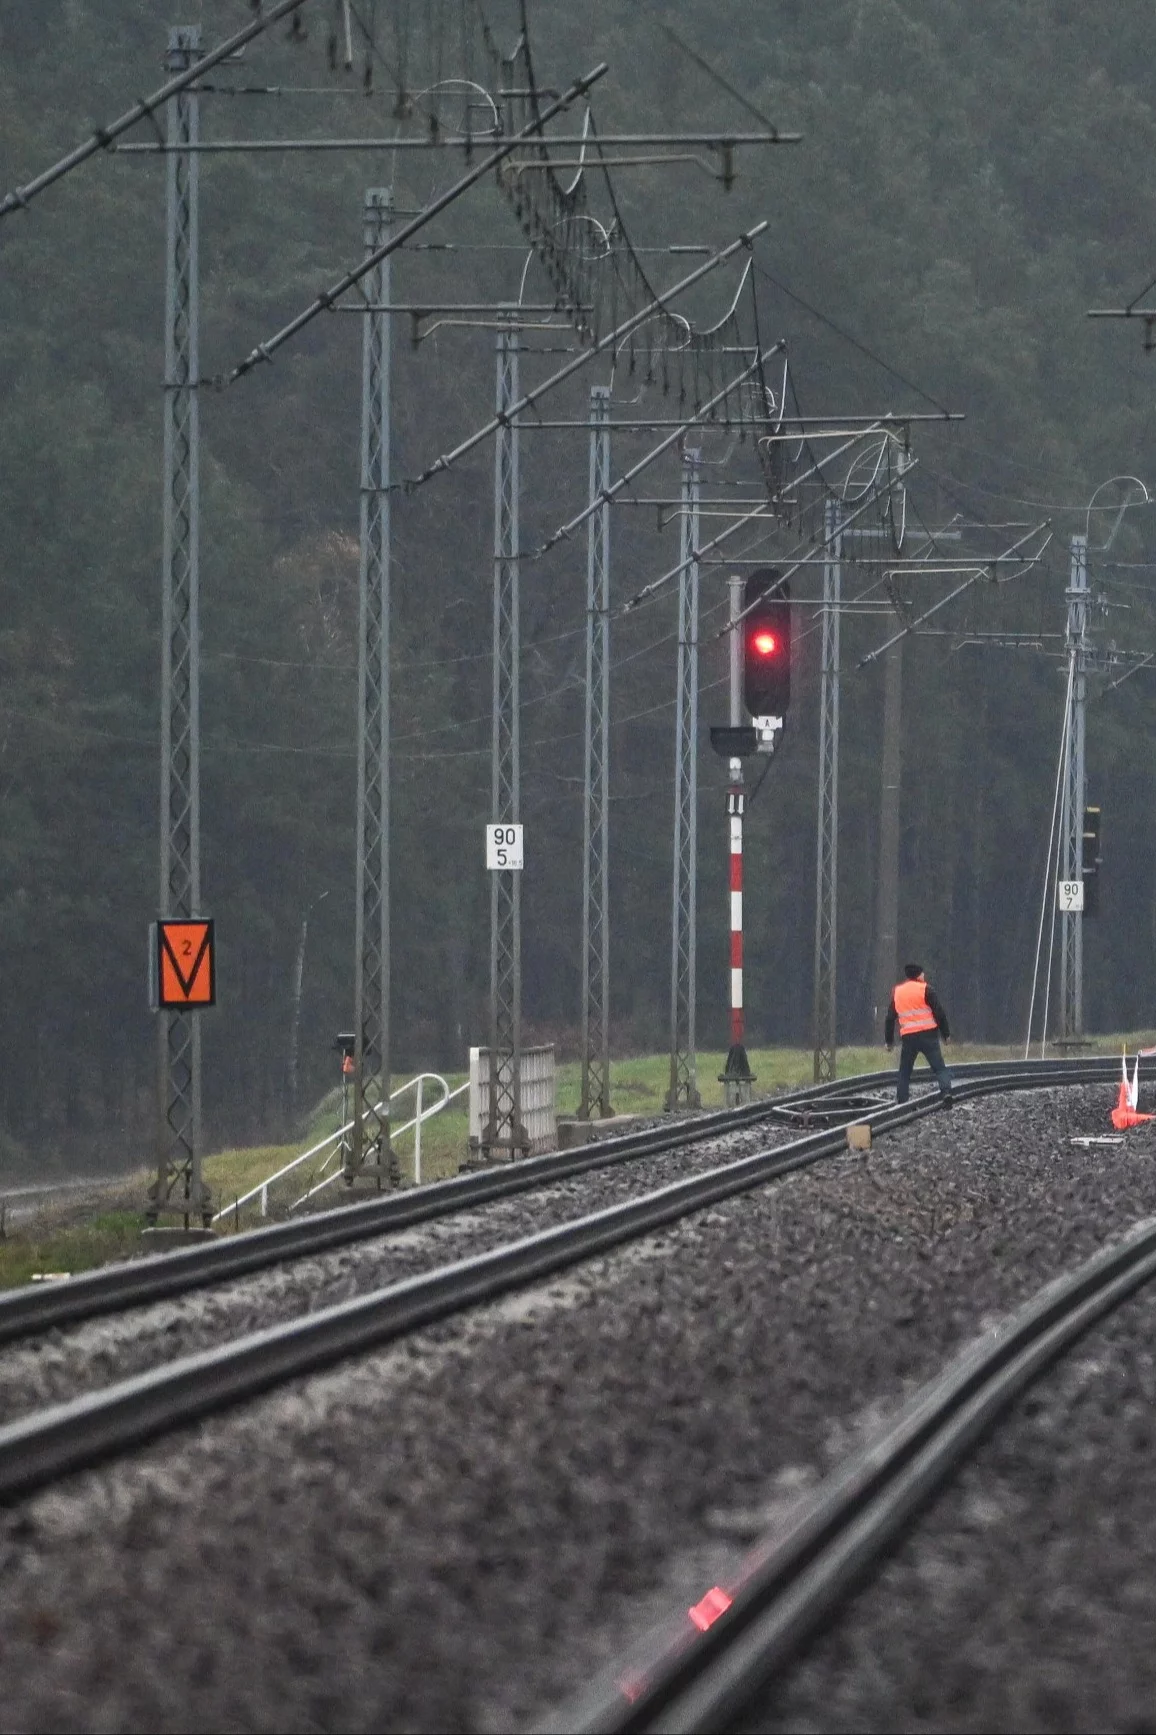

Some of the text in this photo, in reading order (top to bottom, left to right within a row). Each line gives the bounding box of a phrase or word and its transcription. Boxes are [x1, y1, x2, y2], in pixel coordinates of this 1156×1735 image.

[765, 718, 770, 728] A
[494, 828, 516, 846] 90
[497, 849, 507, 866] 5
[1064, 883, 1079, 896] 90
[1066, 896, 1073, 909] 7
[182, 939, 192, 956] 2
